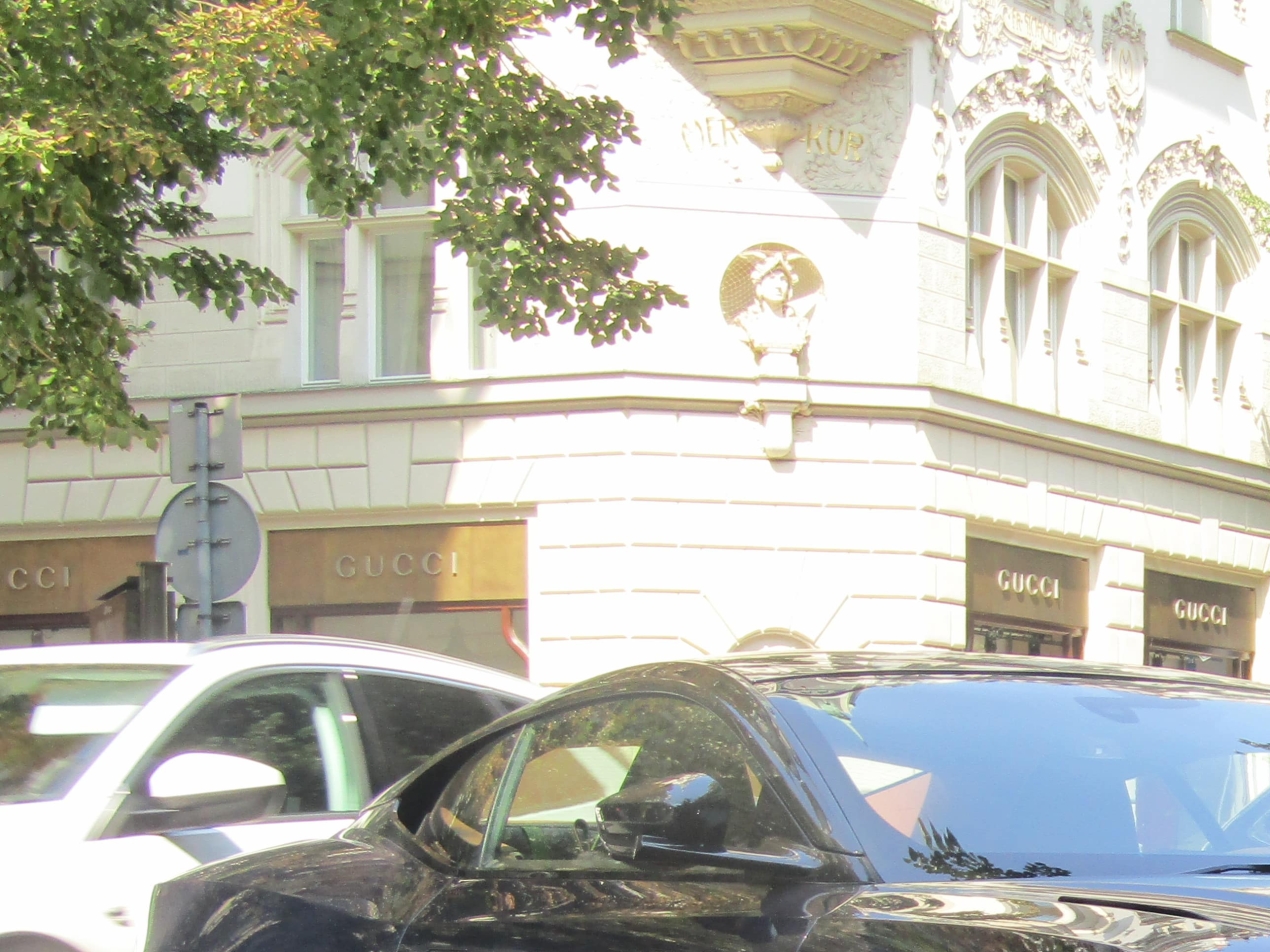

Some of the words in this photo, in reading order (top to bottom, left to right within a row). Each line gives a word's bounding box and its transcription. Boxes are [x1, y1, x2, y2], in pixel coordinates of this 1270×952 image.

[8, 566, 70, 590] CCI
[336, 551, 458, 579] GUCCI
[998, 569, 1060, 600] GUCCI
[1174, 598, 1228, 626] GUCCI
